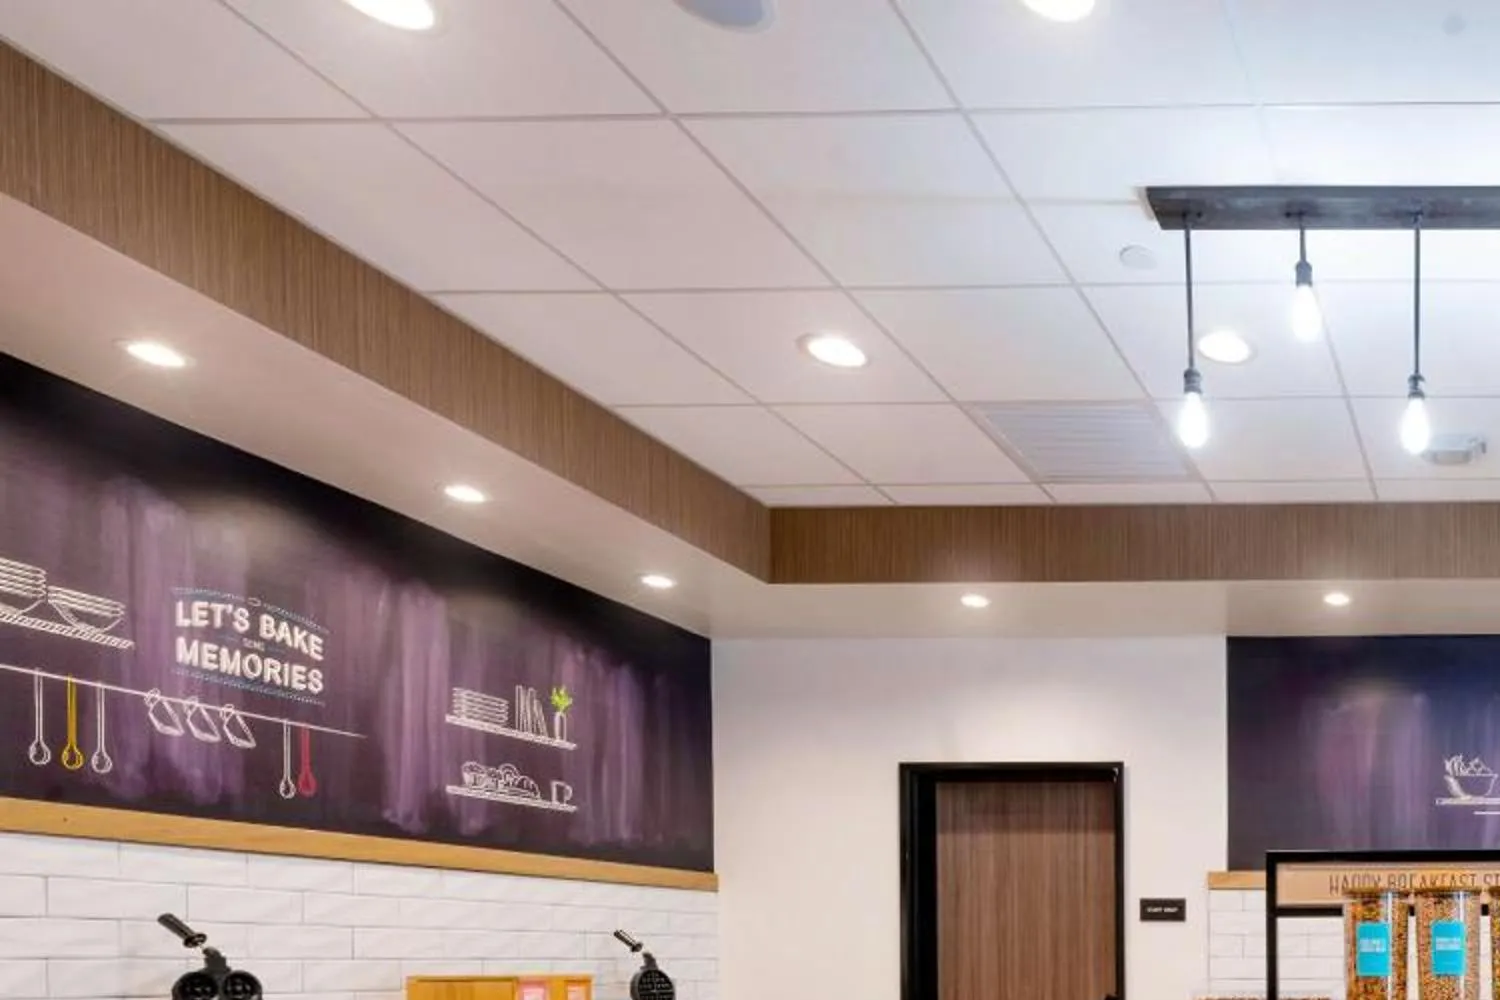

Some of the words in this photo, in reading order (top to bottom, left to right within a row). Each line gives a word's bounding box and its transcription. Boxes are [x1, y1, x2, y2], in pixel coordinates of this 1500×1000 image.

[175, 599, 250, 634] LET'S
[258, 613, 325, 662] BAKE
[175, 635, 325, 695] MEMORIES
